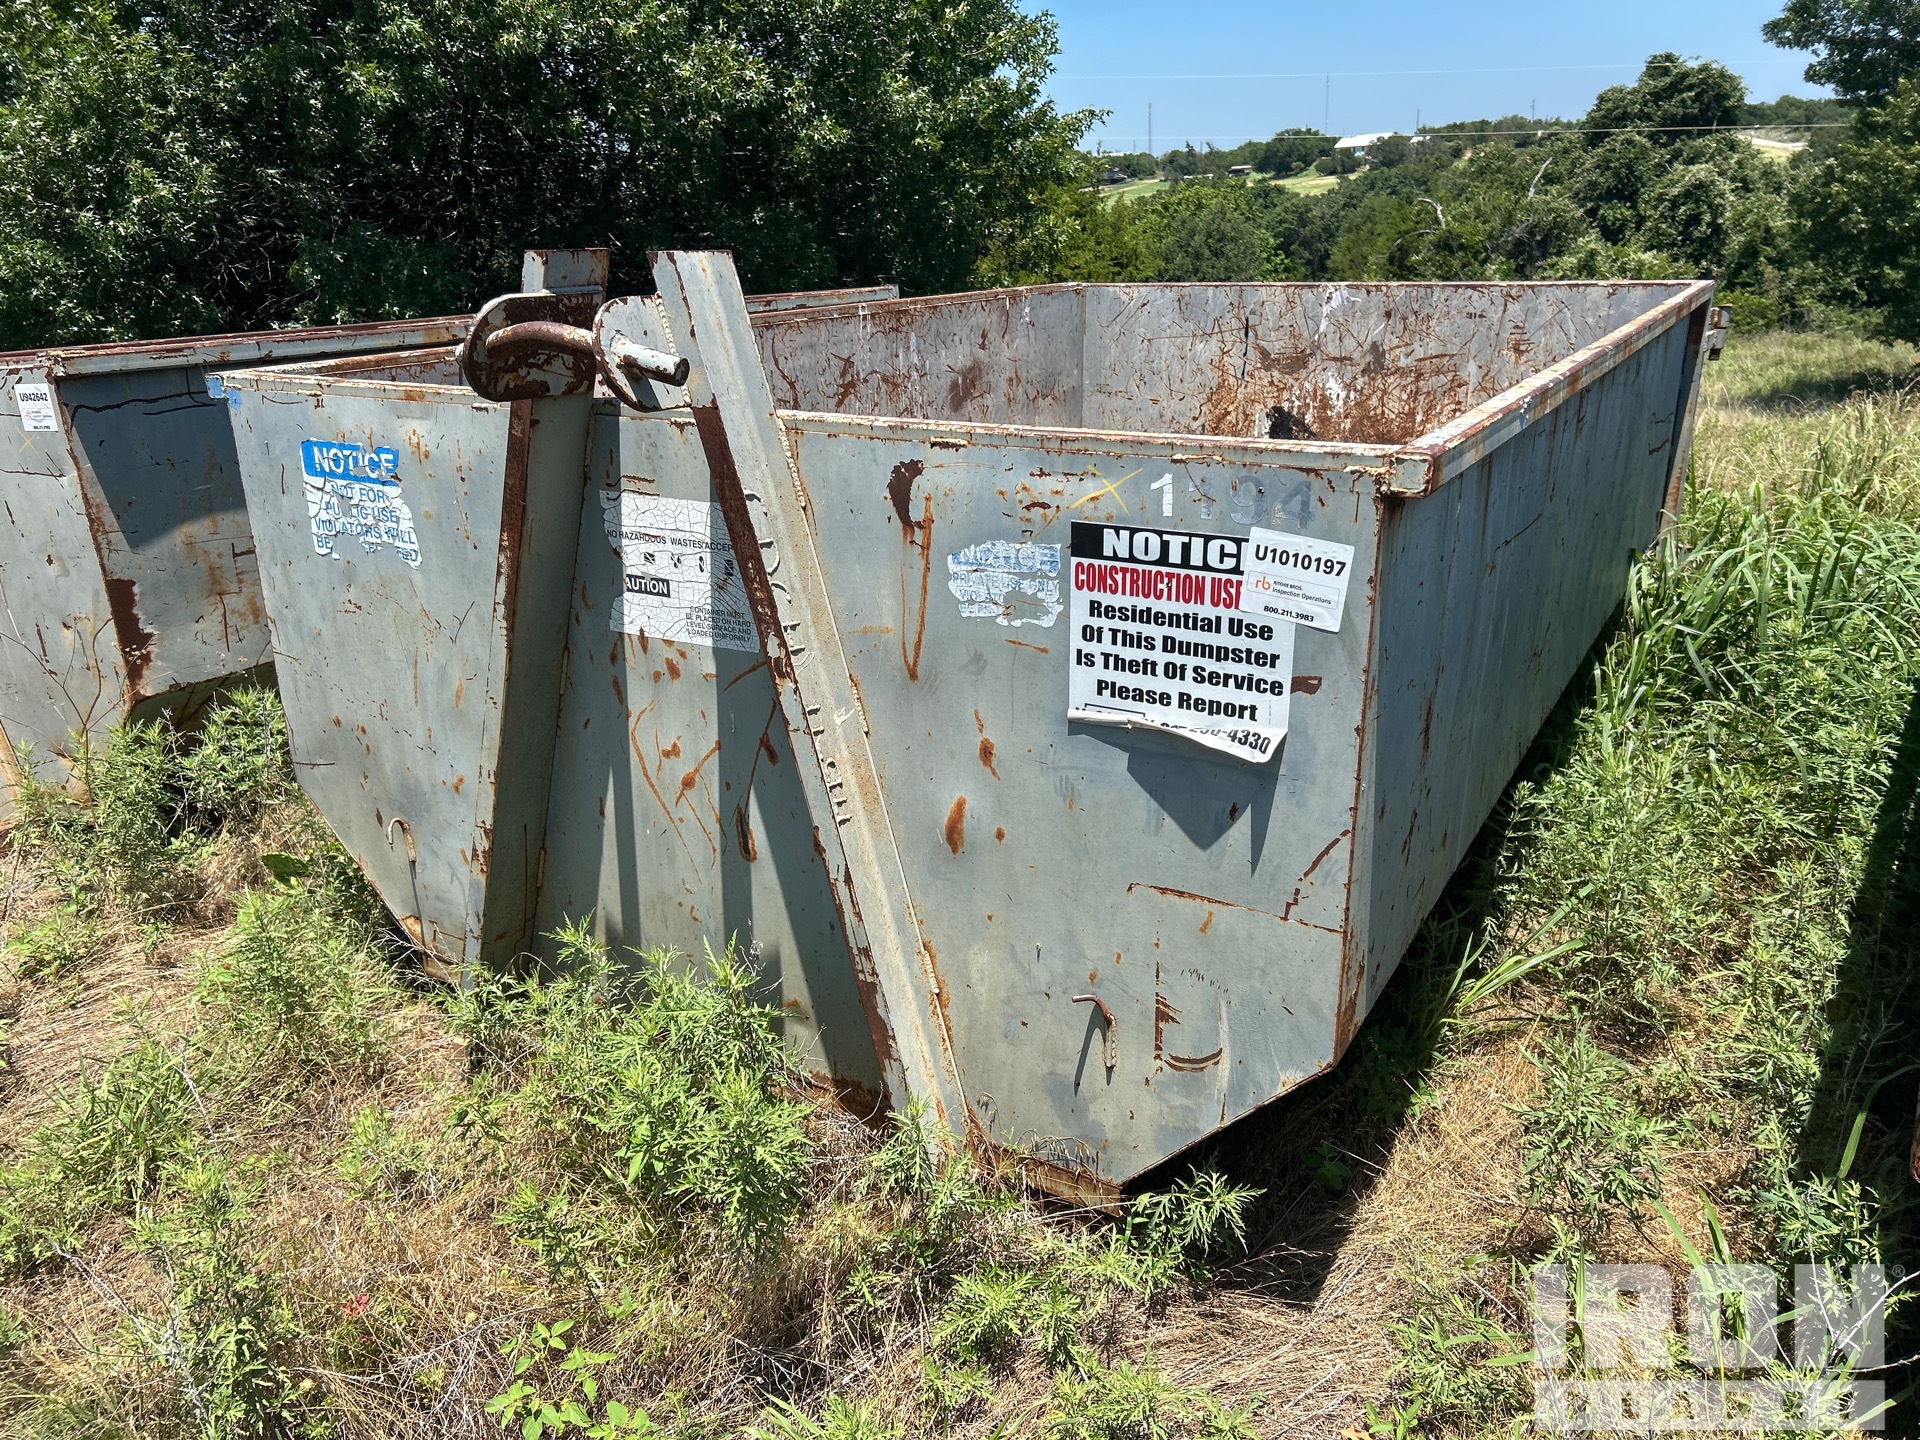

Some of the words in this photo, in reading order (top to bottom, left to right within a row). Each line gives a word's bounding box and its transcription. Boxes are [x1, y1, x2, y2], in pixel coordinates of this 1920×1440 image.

[19, 392, 49, 402] U942642
[358, 487, 386, 503] FOR
[325, 501, 369, 520] PULIC
[317, 535, 332, 549] BE
[620, 531, 667, 545] HAZARDOUS
[670, 536, 703, 549] WASTES
[705, 541, 733, 552] ACCEP
[1255, 544, 1347, 577] U1010197
[625, 578, 668, 595] AUTION
[1074, 562, 1208, 605] CONSTRUCTION
[1272, 587, 1300, 598] Inspection
[1301, 593, 1332, 604] Operations
[1089, 600, 1222, 634] Residential
[1228, 617, 1273, 641] Use
[1263, 605, 1314, 622] 800.211.3983
[732, 620, 751, 628] HARD
[1081, 624, 1104, 643] Of
[1108, 628, 1156, 651] This
[1162, 635, 1280, 669] Dumpster
[1076, 649, 1096, 667] Is
[1100, 652, 1158, 677] Theft
[1163, 661, 1188, 681] Of
[1192, 665, 1284, 697] Service
[1096, 679, 1172, 707] Please
[1178, 691, 1258, 723] Report
